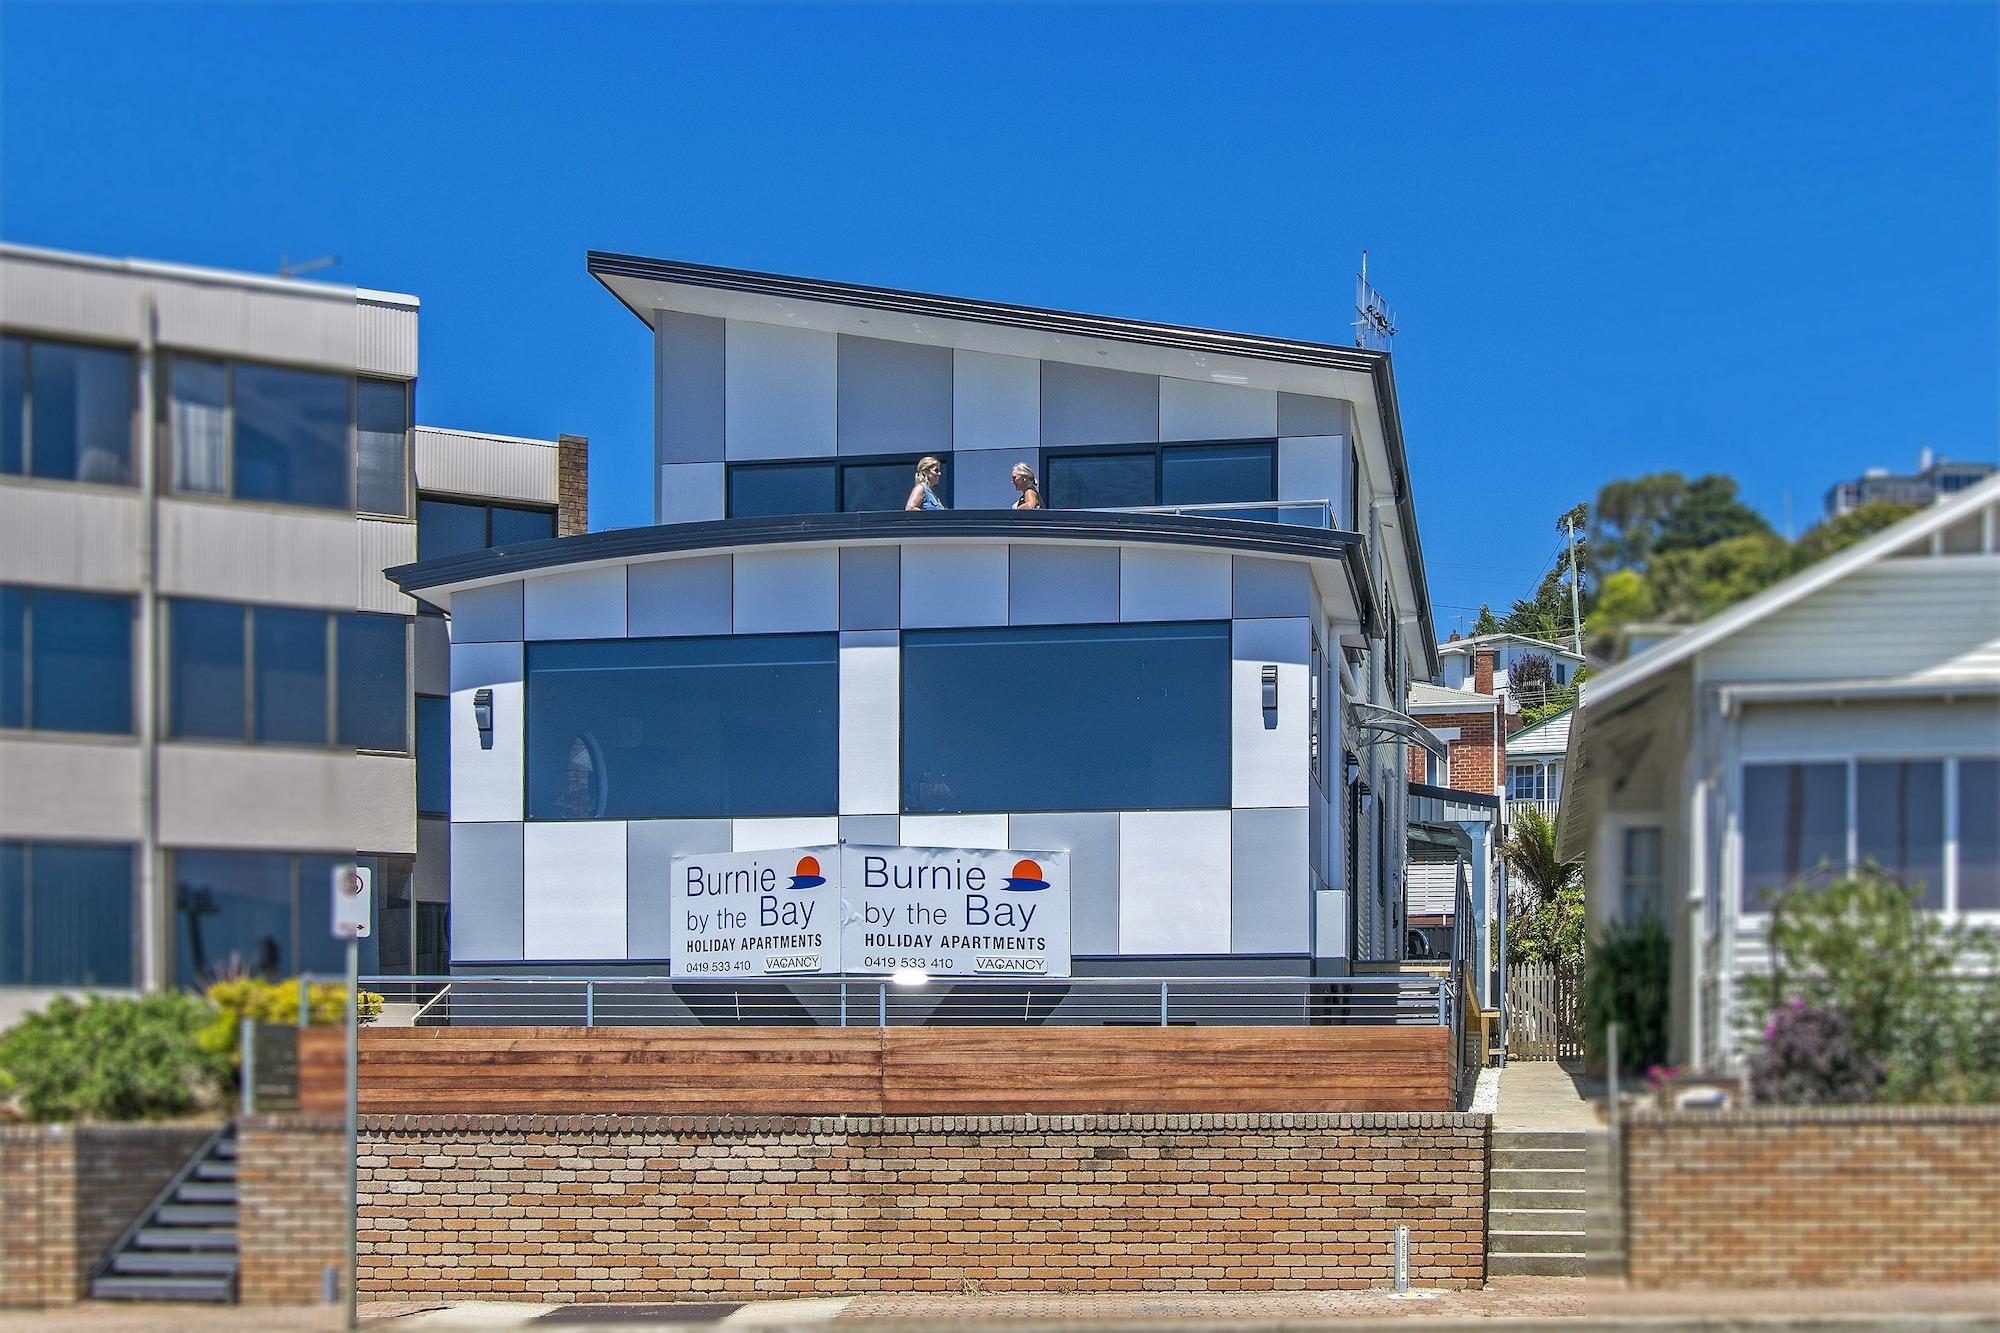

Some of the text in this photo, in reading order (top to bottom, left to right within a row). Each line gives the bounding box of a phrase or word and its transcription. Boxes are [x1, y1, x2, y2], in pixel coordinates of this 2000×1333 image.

[687, 861, 776, 897] Burnie
[864, 855, 986, 891] Burnie
[687, 895, 815, 934] by the Bay
[865, 894, 1037, 933] by the Bay
[687, 933, 822, 953] HOLIDAY APARTMENTS
[865, 933, 1046, 950] HOLIDAY APARTMENTS
[686, 960, 751, 973] 0419 533 410
[765, 956, 819, 969] VACANCY
[864, 956, 953, 969] 0419 533 410
[976, 957, 1045, 970] VACANCY
